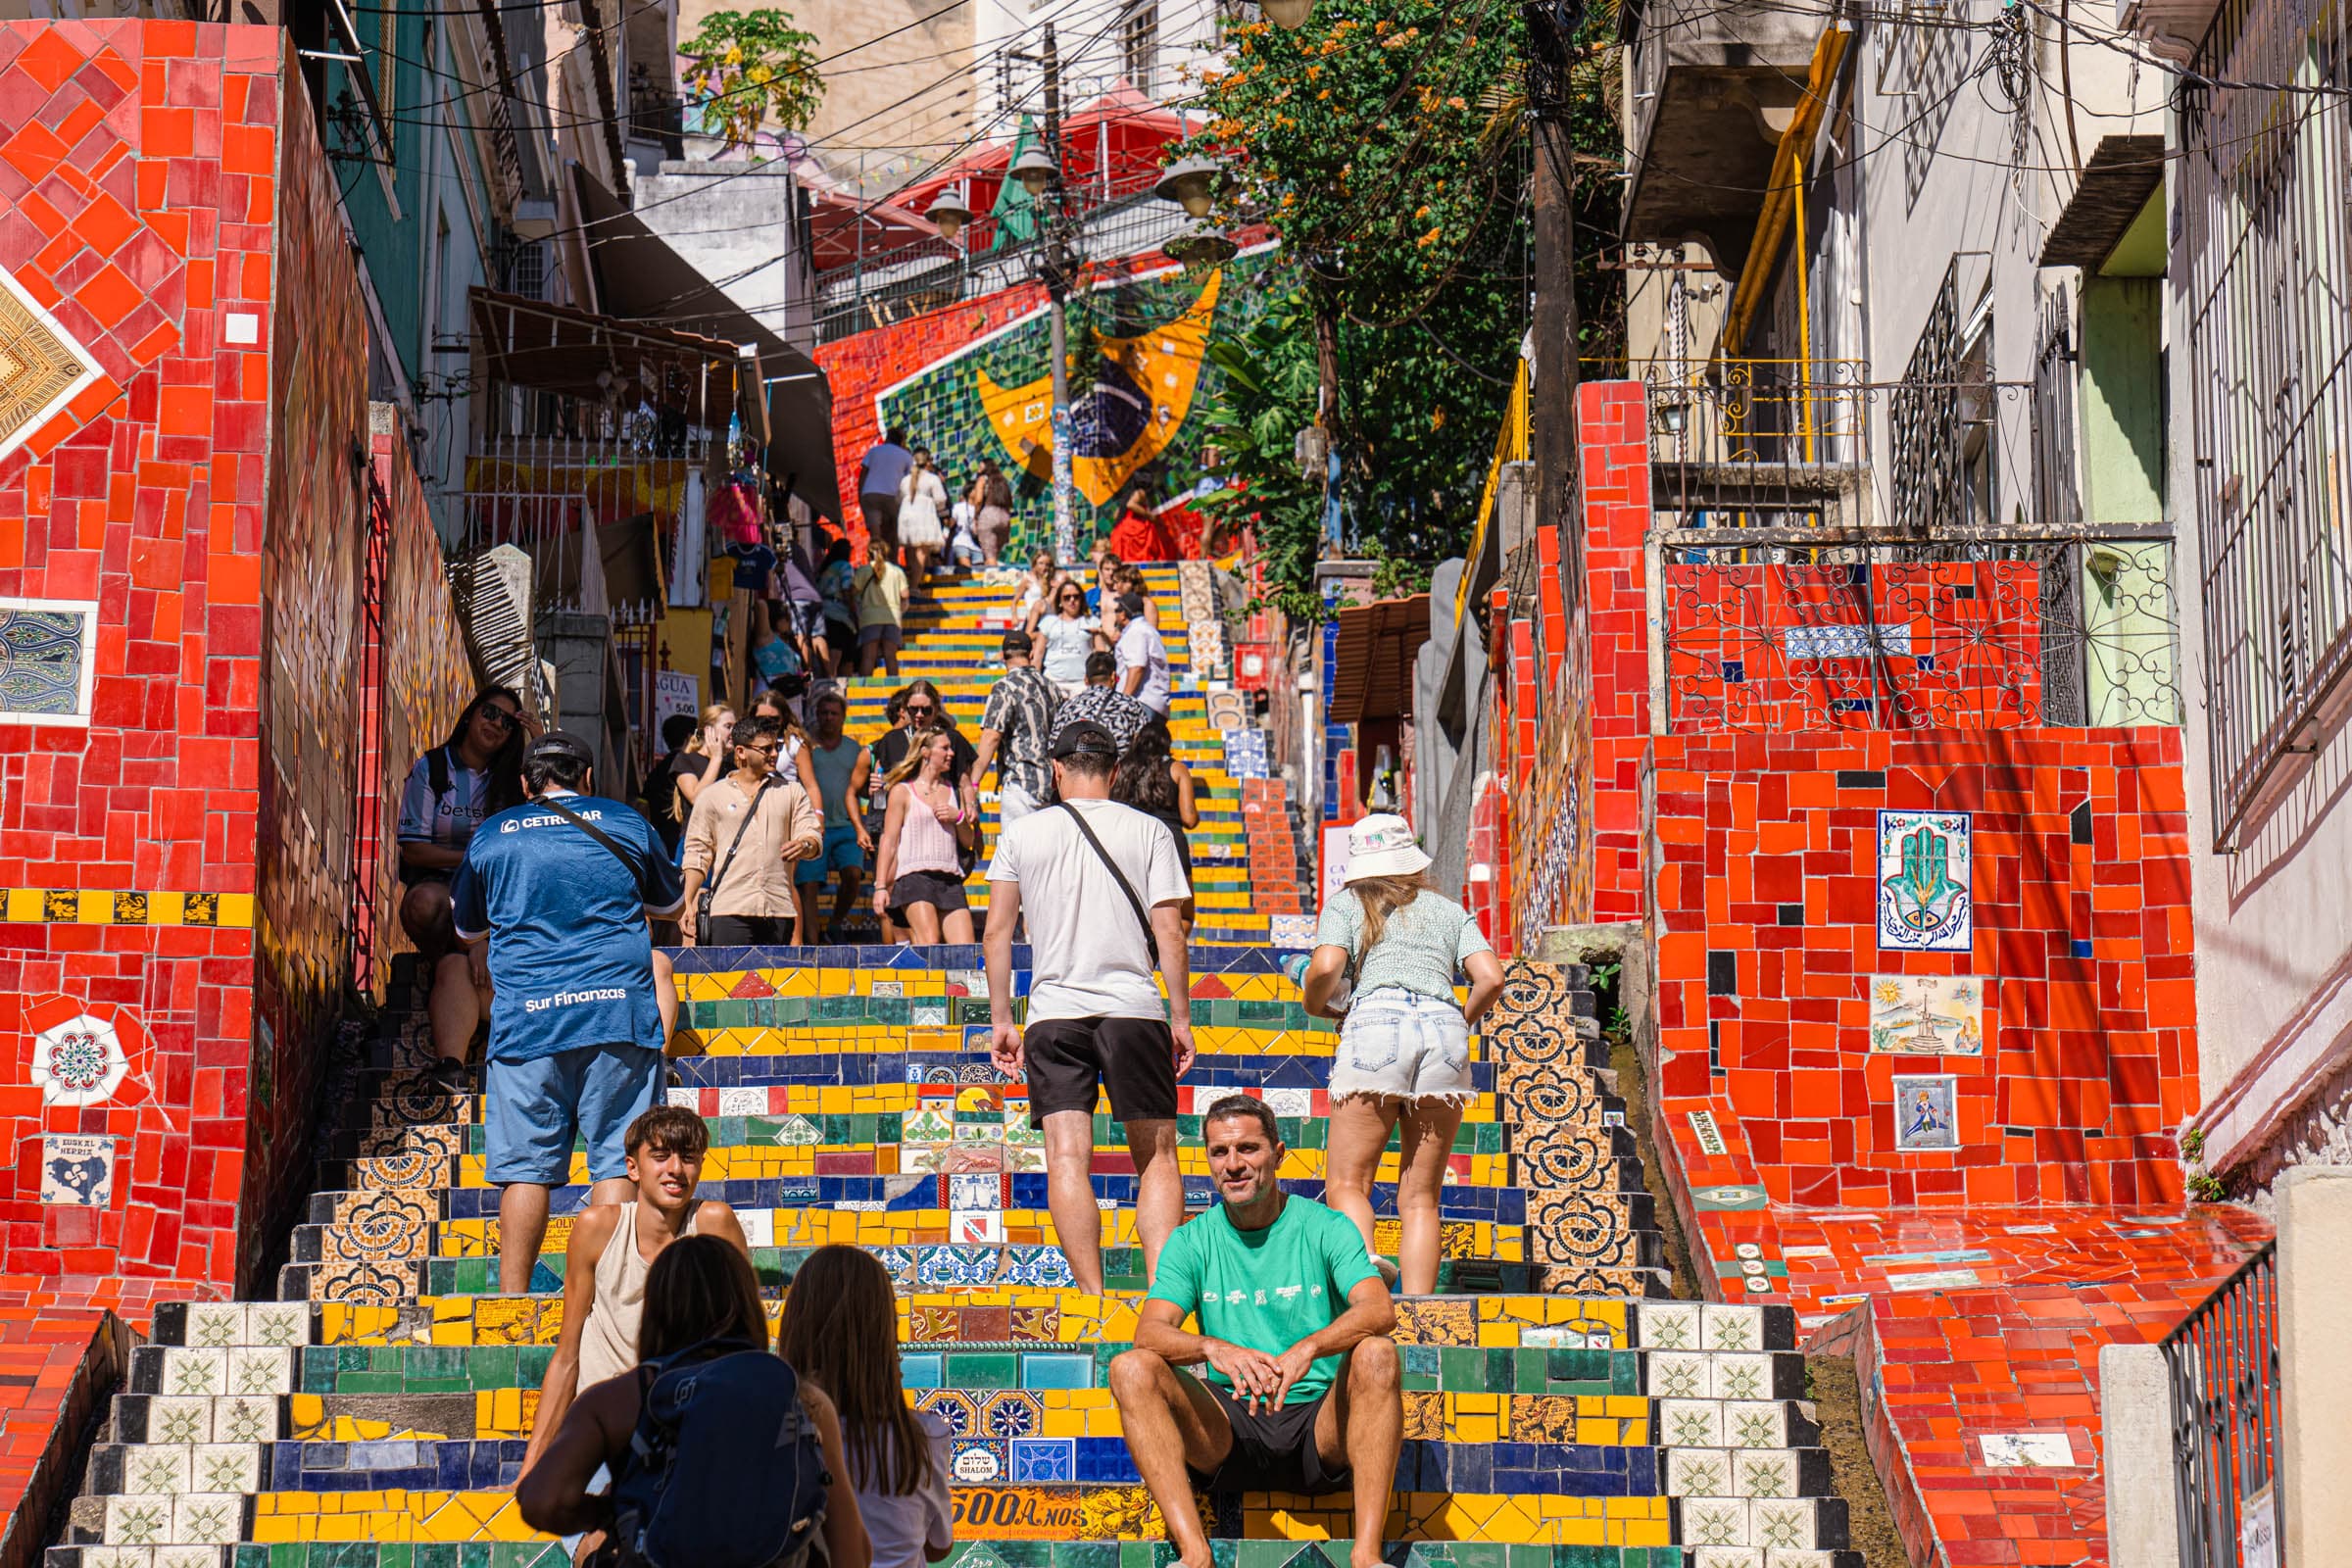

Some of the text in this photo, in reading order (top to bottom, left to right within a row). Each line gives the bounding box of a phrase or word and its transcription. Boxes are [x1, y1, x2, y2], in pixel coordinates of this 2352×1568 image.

[441, 801, 487, 818] bets
[522, 809, 603, 828] CETRAR
[525, 988, 627, 1012] Sur Finanzas
[62, 1139, 95, 1148] EUSKAL
[962, 1452, 991, 1465] שלום
